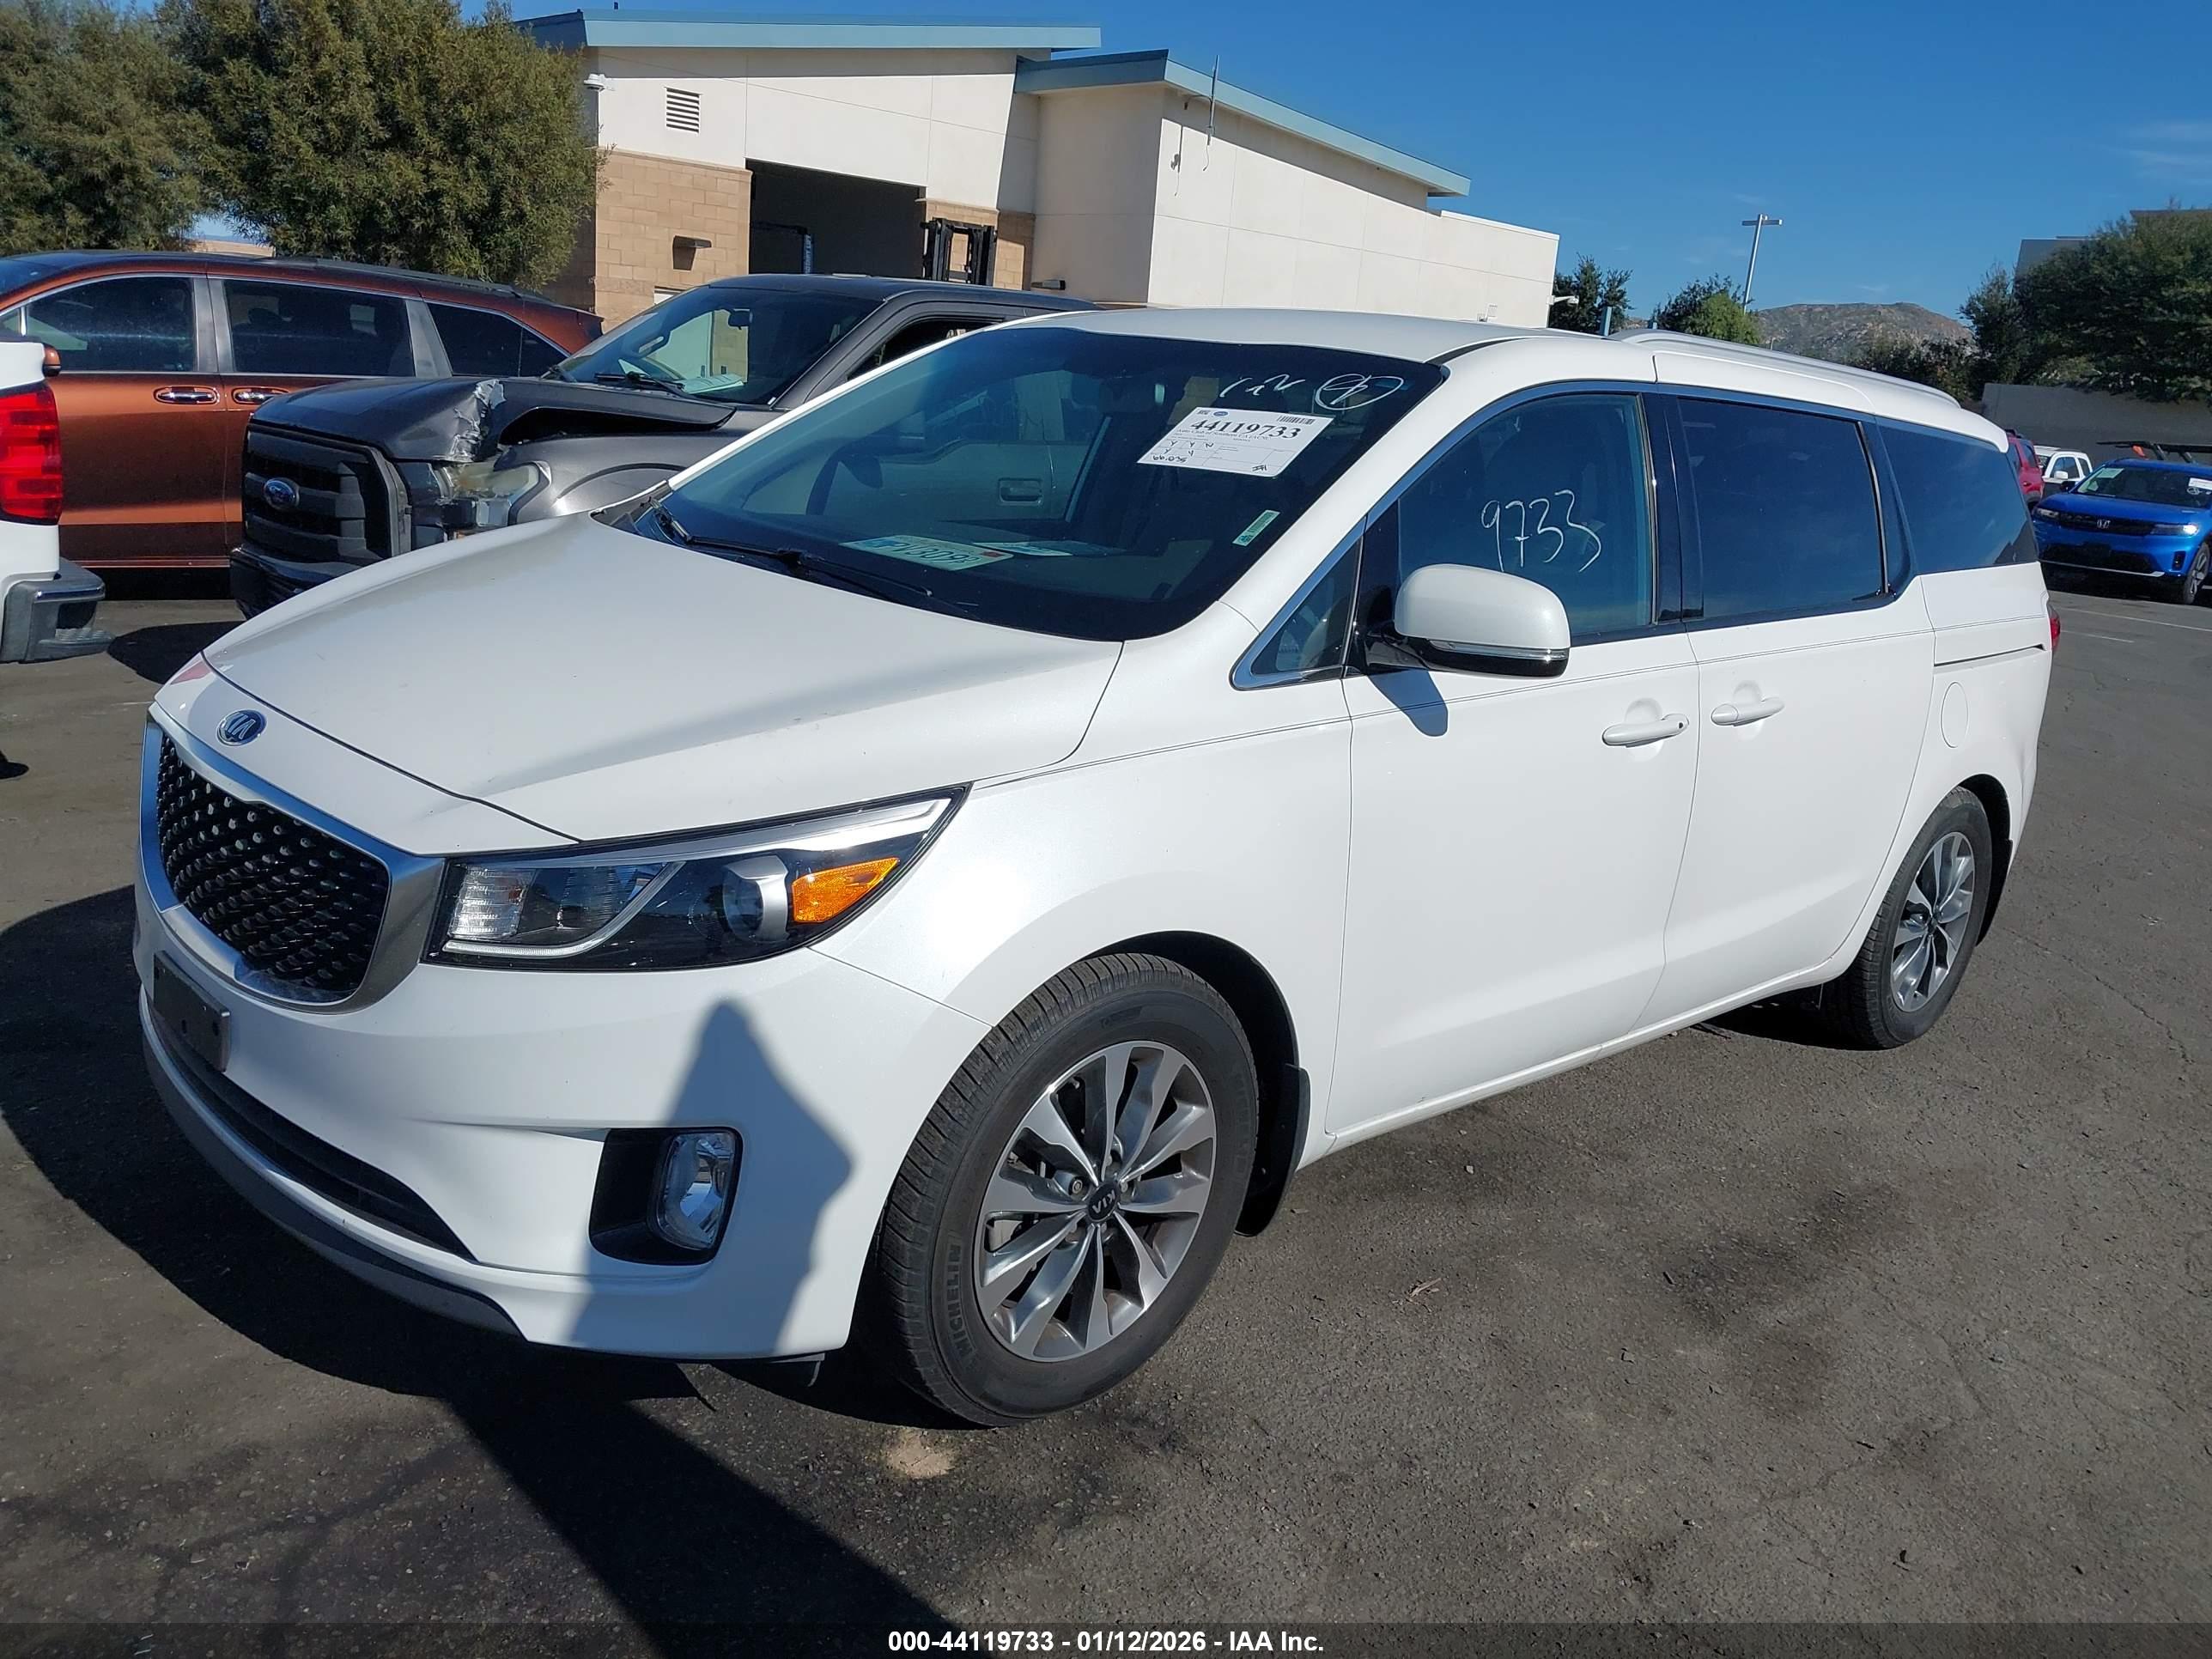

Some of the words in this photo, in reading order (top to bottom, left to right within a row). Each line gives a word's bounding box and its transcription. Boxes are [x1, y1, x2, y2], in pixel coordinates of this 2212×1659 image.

[1190, 419, 1301, 439] 44119733
[1481, 489, 1601, 573] 9733
[1092, 1189, 1115, 1213] KIA
[945, 1243, 974, 1358] MICHELIN
